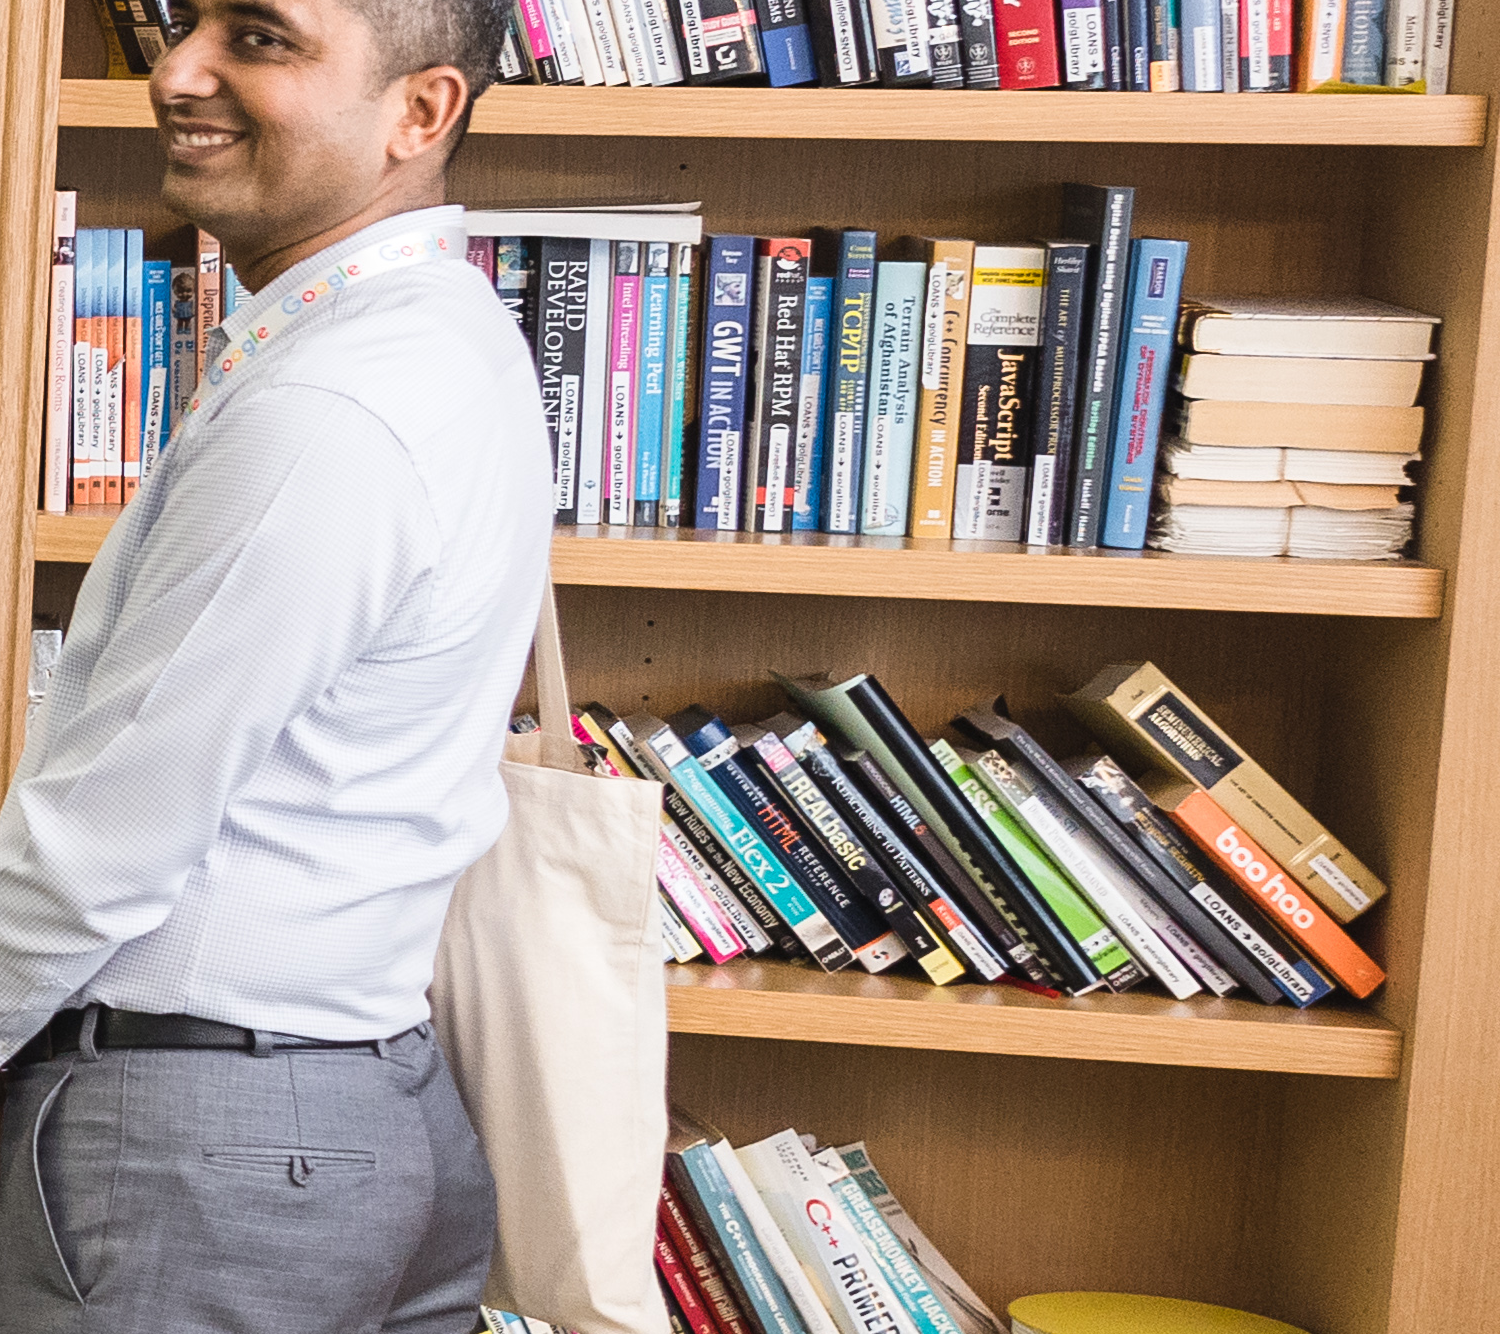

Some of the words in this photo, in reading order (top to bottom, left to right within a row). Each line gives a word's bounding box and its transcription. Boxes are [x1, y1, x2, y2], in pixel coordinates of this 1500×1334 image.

[1111, 193, 1125, 226] Digital
[378, 232, 449, 261] Google
[1109, 226, 1122, 251] Design
[280, 263, 361, 315] Google
[566, 260, 588, 331] RAPID
[622, 281, 635, 309] Intel
[777, 294, 799, 331] Red
[886, 302, 895, 319] of
[617, 309, 634, 370] Threading
[645, 280, 666, 358] Learning
[839, 297, 862, 373] TCP/IP
[902, 295, 916, 353] Terrain
[972, 322, 1036, 337] Reference
[979, 311, 1038, 326] Complete
[55, 338, 66, 373] Guest
[208, 326, 270, 386] Google
[541, 260, 567, 432] DEVELOPMENT
[712, 320, 744, 376] GWT
[775, 334, 795, 371] Hat
[878, 323, 895, 416] Afghanistan
[53, 374, 65, 413] Rooms
[646, 359, 662, 395] Perl
[717, 381, 733, 401] IN
[772, 372, 794, 417] RPM
[894, 358, 911, 425] Analysis
[930, 337, 958, 427] Concurrency
[977, 384, 991, 418] Second
[564, 381, 575, 424] LOANS
[615, 385, 625, 427] LOANS
[988, 348, 1025, 461] JavaScript
[706, 403, 732, 470] ACTION
[931, 429, 947, 444] IN
[973, 419, 989, 460] Edition
[927, 446, 945, 487] ACTION
[1147, 712, 1201, 762] ALGORITHMS
[682, 767, 735, 830] Programming
[729, 825, 774, 878] Flex
[766, 875, 790, 896] 2
[788, 777, 868, 873] REALbasic
[831, 774, 885, 842] REFACTORING
[880, 839, 899, 854] TO
[894, 849, 933, 898] PATTERNS
[889, 794, 929, 836] HTML5
[665, 791, 687, 816] New
[683, 815, 709, 844] Rules
[721, 860, 742, 887] New
[738, 883, 780, 929] Economy
[757, 803, 802, 855] HTML
[796, 845, 851, 910] REFERENCE
[1215, 825, 1268, 883] boo
[1261, 873, 1315, 930] hoo
[1203, 893, 1242, 932] LOANS
[717, 1201, 731, 1220] THE
[724, 1219, 747, 1250] C++
[804, 1198, 840, 1249] C++
[841, 1182, 928, 1303] GREASEMONKEY
[657, 1240, 676, 1266] NSW
